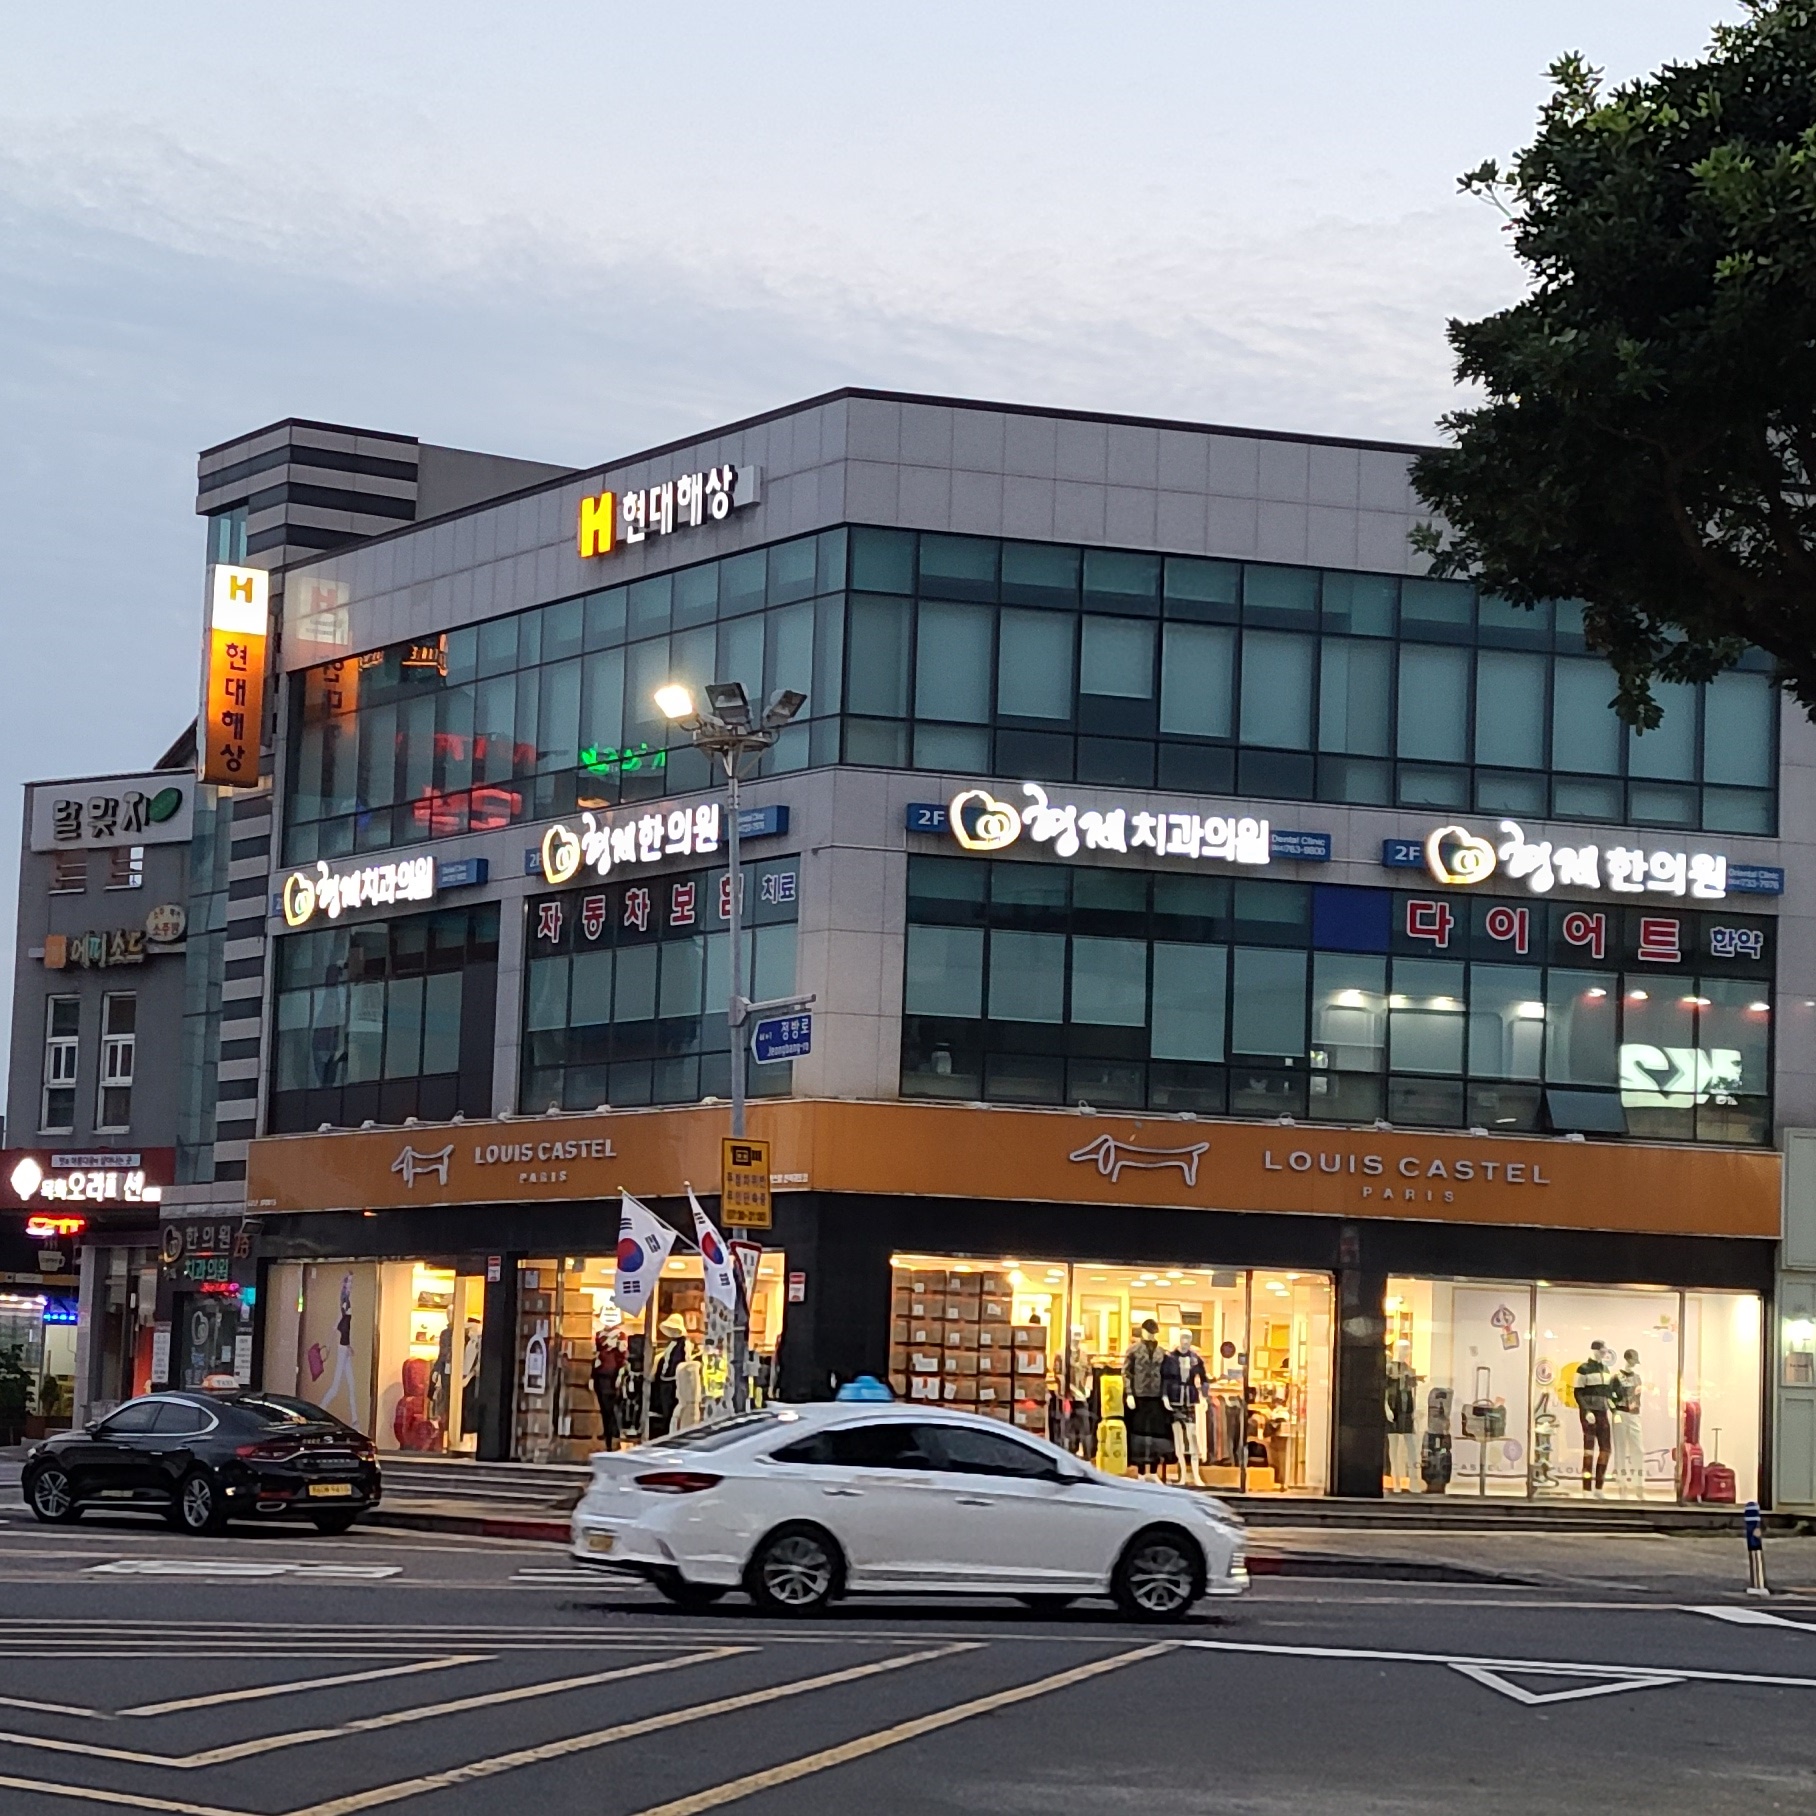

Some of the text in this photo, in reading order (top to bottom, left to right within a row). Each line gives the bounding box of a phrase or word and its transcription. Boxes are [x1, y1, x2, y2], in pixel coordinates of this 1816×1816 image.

[622, 464, 738, 544] 현대해상
[229, 575, 253, 604] H
[220, 643, 248, 772] 현대해상
[918, 809, 945, 826] 2F
[1394, 845, 1421, 861] 2F
[762, 872, 796, 904] 치료
[1406, 900, 1764, 963] 다이어트 한약
[781, 1018, 809, 1041] 정방로
[474, 1139, 617, 1164] LOUIS CASTEL
[519, 1171, 567, 1184] PARIS
[1264, 1150, 1550, 1184] LOUIS CASTEL
[1362, 1186, 1454, 1203] PARIS
[186, 1225, 231, 1250] 한의원
[185, 1258, 229, 1281] 치과의원
